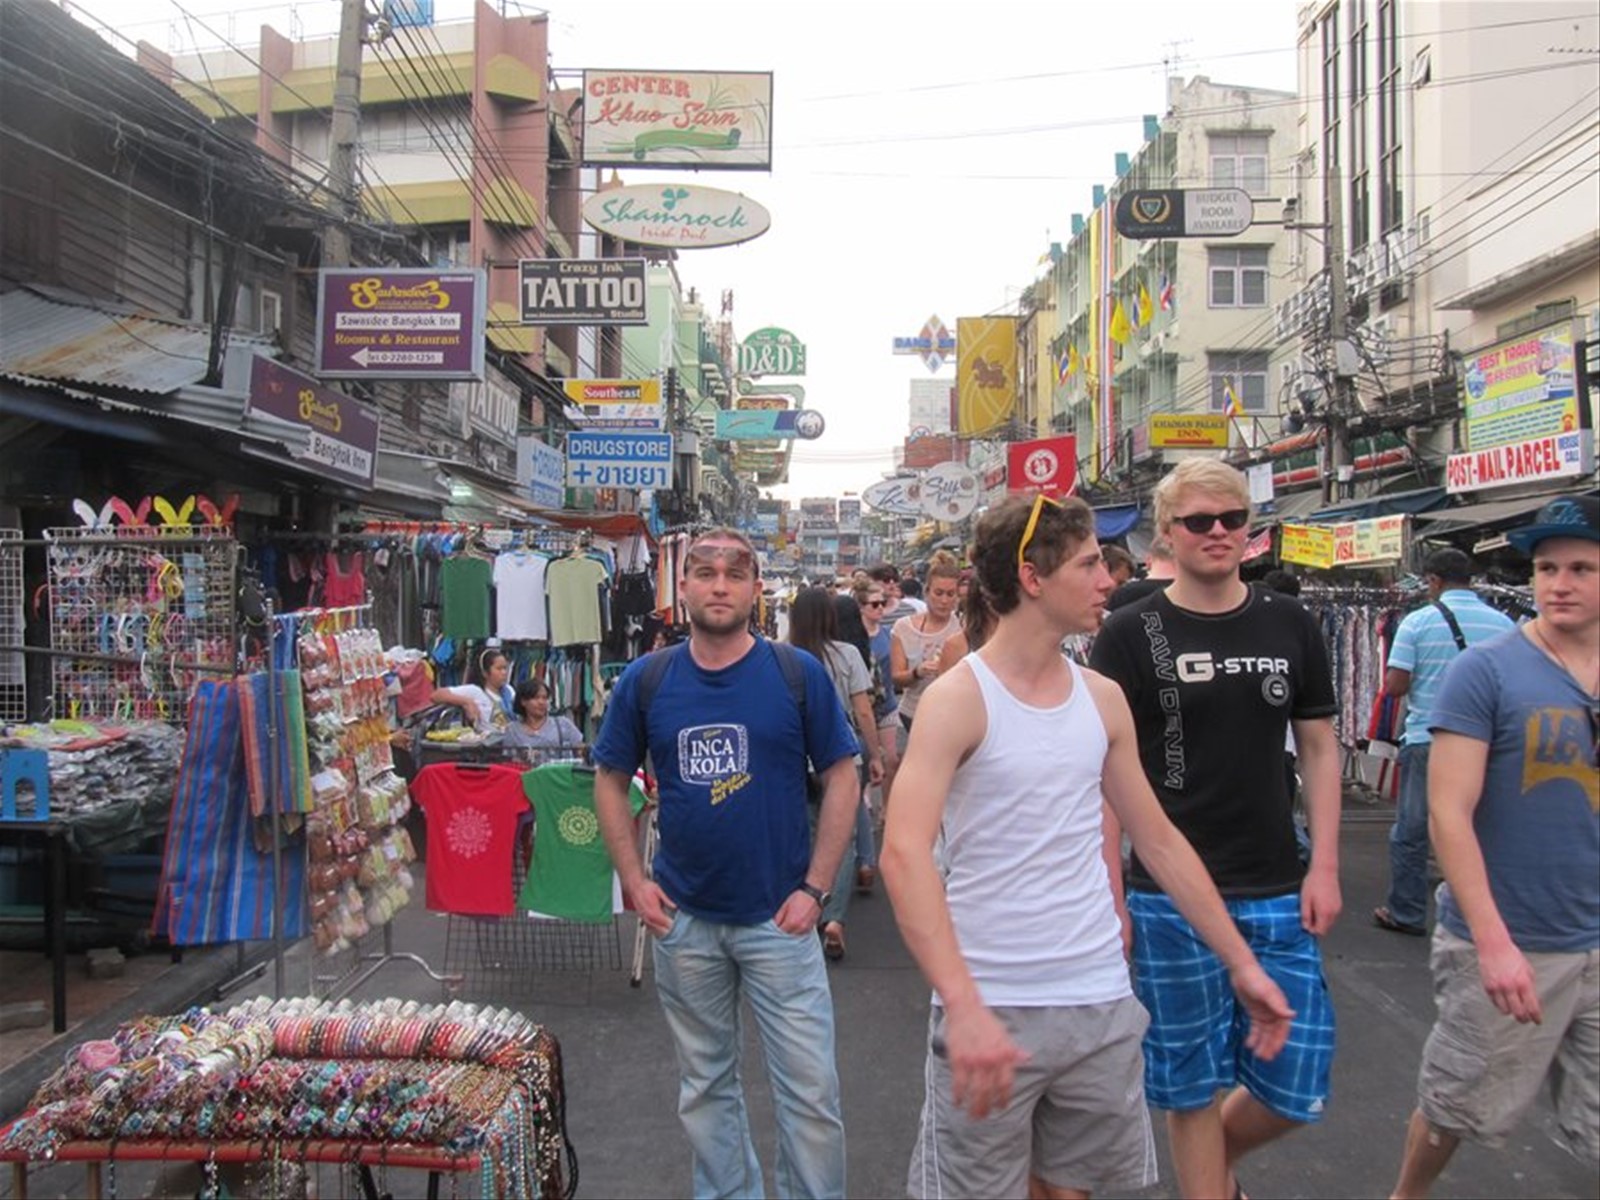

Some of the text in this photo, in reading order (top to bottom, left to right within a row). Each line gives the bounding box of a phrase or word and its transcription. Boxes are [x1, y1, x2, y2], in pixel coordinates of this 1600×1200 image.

[588, 75, 690, 98] CENTER
[597, 98, 741, 128] Khao Sarn
[601, 198, 748, 227] Shamrock
[1201, 207, 1234, 217] ROOM
[641, 226, 708, 241] Irish Pub
[559, 262, 598, 275] Crazy
[602, 262, 623, 273] Ink
[523, 277, 643, 309] TATTOO
[340, 313, 456, 328] Sawasdee Bangkok Inn
[610, 310, 644, 319] Studio
[335, 332, 460, 345] Rooms & Restaurant
[742, 343, 794, 374] D&D
[584, 386, 641, 399] Southeast
[1177, 429, 1203, 438] INN
[314, 436, 351, 466] Bangkok
[352, 450, 366, 471] Inn
[570, 439, 669, 457] DRUGSTORE
[1447, 437, 1561, 488] POST-MAIL PARCEL
[596, 465, 667, 487] ขายยา
[1141, 611, 1177, 682] RAW
[1175, 652, 1290, 683] G-STAR
[690, 738, 734, 757] INCA
[689, 756, 738, 775] KOLA
